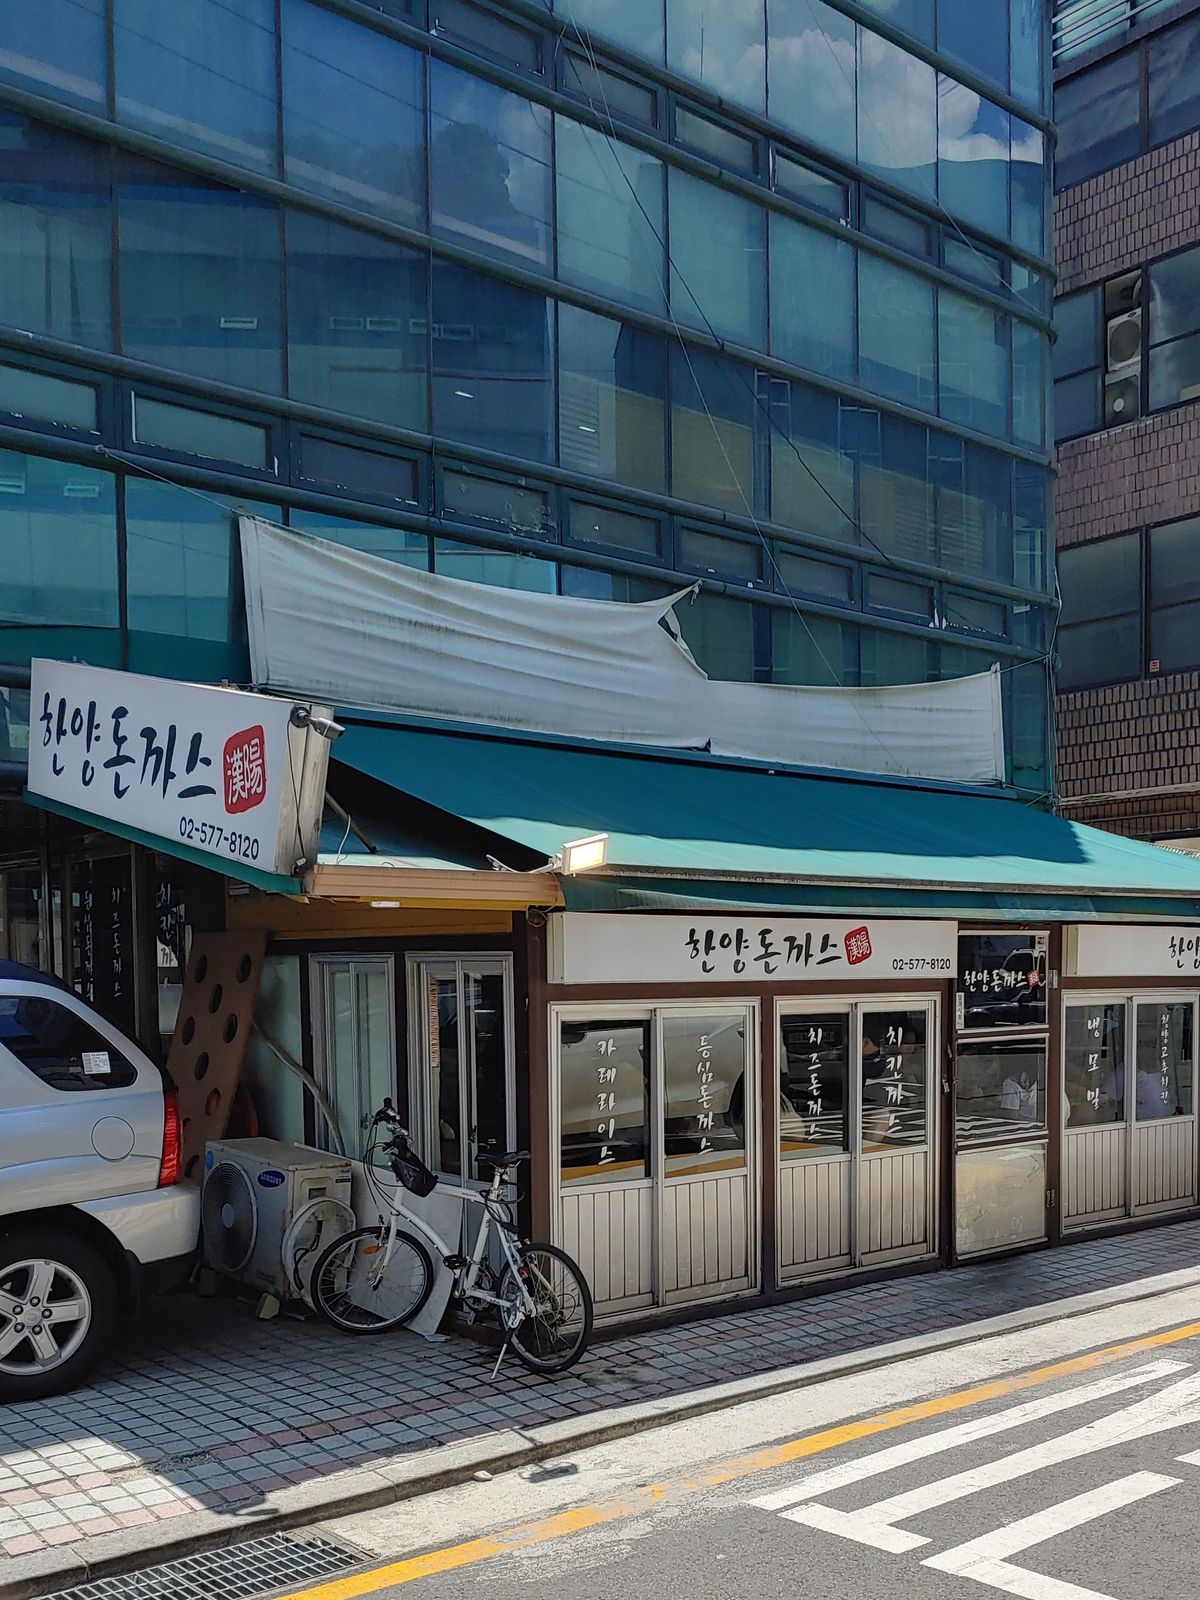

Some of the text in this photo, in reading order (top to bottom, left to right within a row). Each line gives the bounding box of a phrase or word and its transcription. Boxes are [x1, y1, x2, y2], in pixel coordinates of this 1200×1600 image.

[40, 692, 216, 800] 한양돈까스
[226, 737, 263, 805] 漢陽
[179, 816, 260, 860] 02-577-8120
[685, 928, 842, 973] 한양돈까스
[892, 957, 951, 971] 02-577-8120
[963, 969, 1028, 992] 한양돈까스
[597, 1038, 617, 1165] 카레라이스
[697, 1035, 714, 1155] 등심돈까스
[807, 1027, 823, 1140] 치즈돈까스
[886, 1026, 903, 1134] 치킨까스
[1087, 1016, 1100, 1111] 냉모밀
